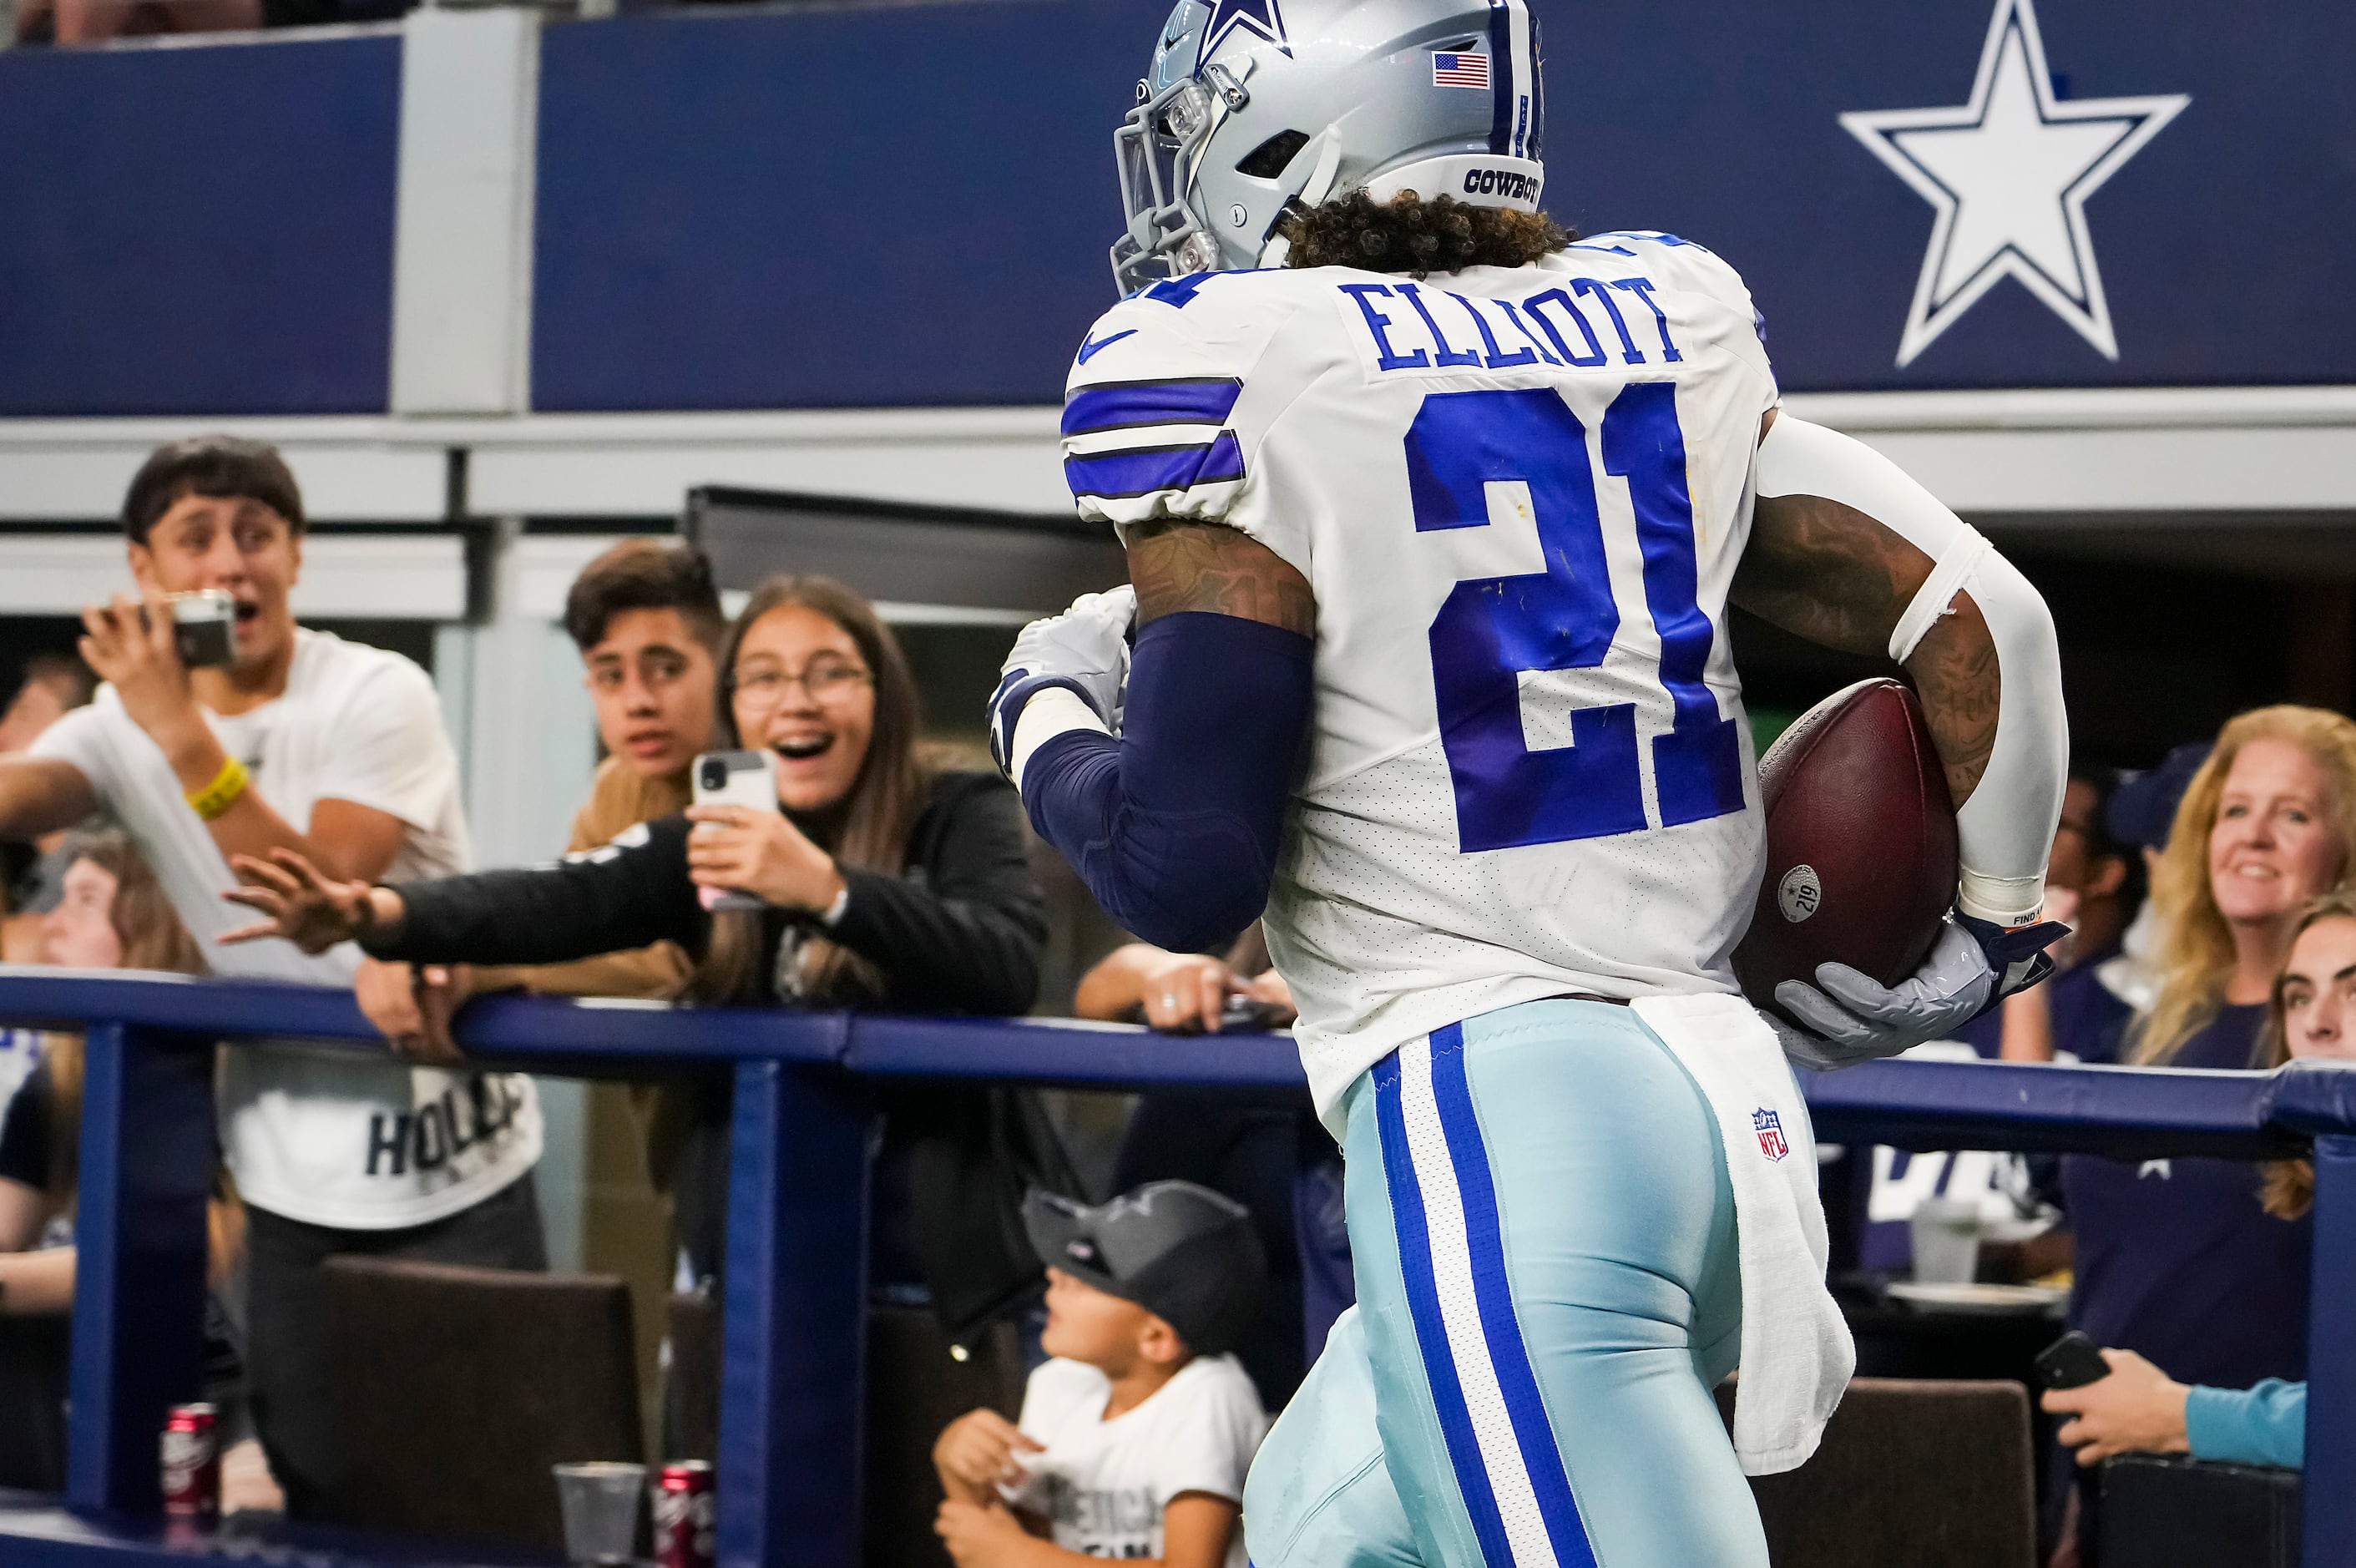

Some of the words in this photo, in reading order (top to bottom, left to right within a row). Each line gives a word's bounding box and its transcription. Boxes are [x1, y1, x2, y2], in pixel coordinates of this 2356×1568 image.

[1337, 277, 1683, 371] ELLIOTT
[1403, 382, 1747, 854] 21
[1796, 885, 1818, 913] 219
[2013, 913, 2035, 925] FIND
[1757, 1130, 1787, 1159] NFL
